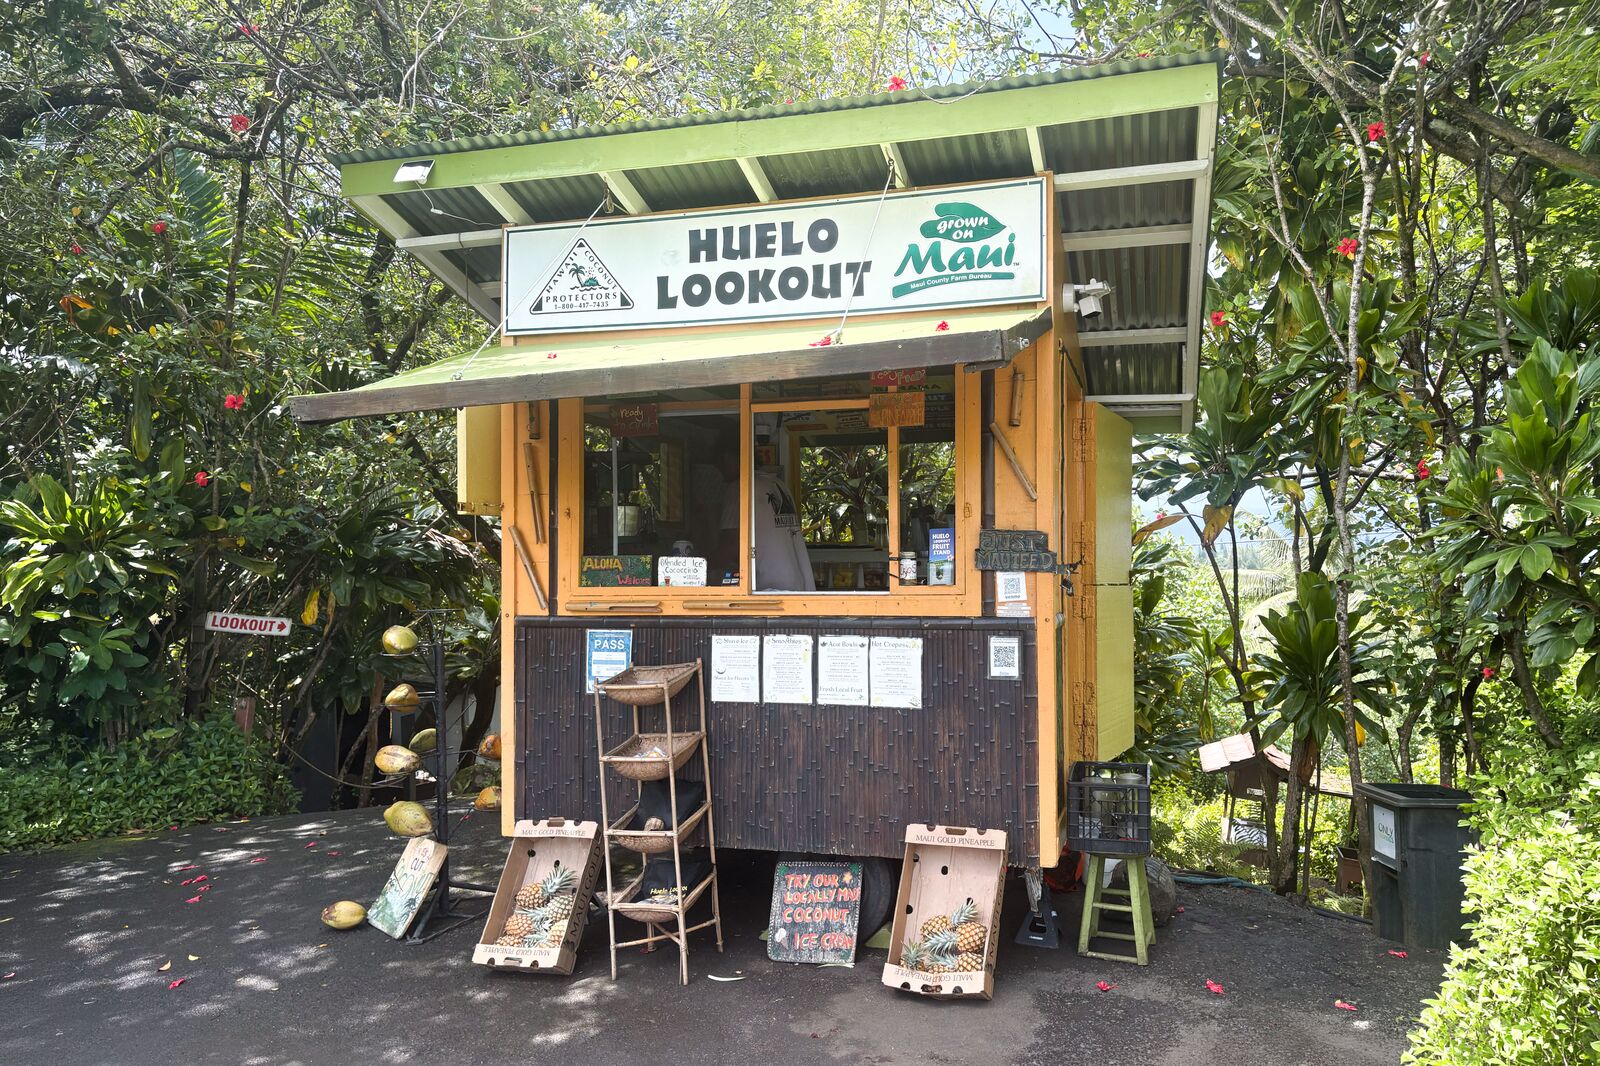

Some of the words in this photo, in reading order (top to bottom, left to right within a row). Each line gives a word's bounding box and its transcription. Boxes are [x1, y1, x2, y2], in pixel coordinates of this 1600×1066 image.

[937, 216, 989, 234] grown
[688, 218, 839, 263] HUELO
[952, 229, 974, 240] on
[894, 232, 1016, 277] Maui
[546, 251, 578, 294] HAWAII
[584, 250, 618, 290] COCONUT
[657, 260, 872, 310] LOOKOUT
[926, 277, 950, 285] County
[545, 292, 617, 303] PROTECTORS
[620, 405, 644, 422] ready
[583, 557, 624, 572] ALOHA
[211, 615, 276, 632] LOOKOUT
[594, 639, 625, 650] PASS
[916, 834, 935, 842] MAUI
[958, 838, 995, 846] PINEAPPLE
[784, 874, 812, 890] TRY
[812, 874, 839, 888] OUR
[784, 888, 836, 904] LOCALLY
[782, 906, 850, 925] COCONUT
[794, 932, 819, 950] ICE
